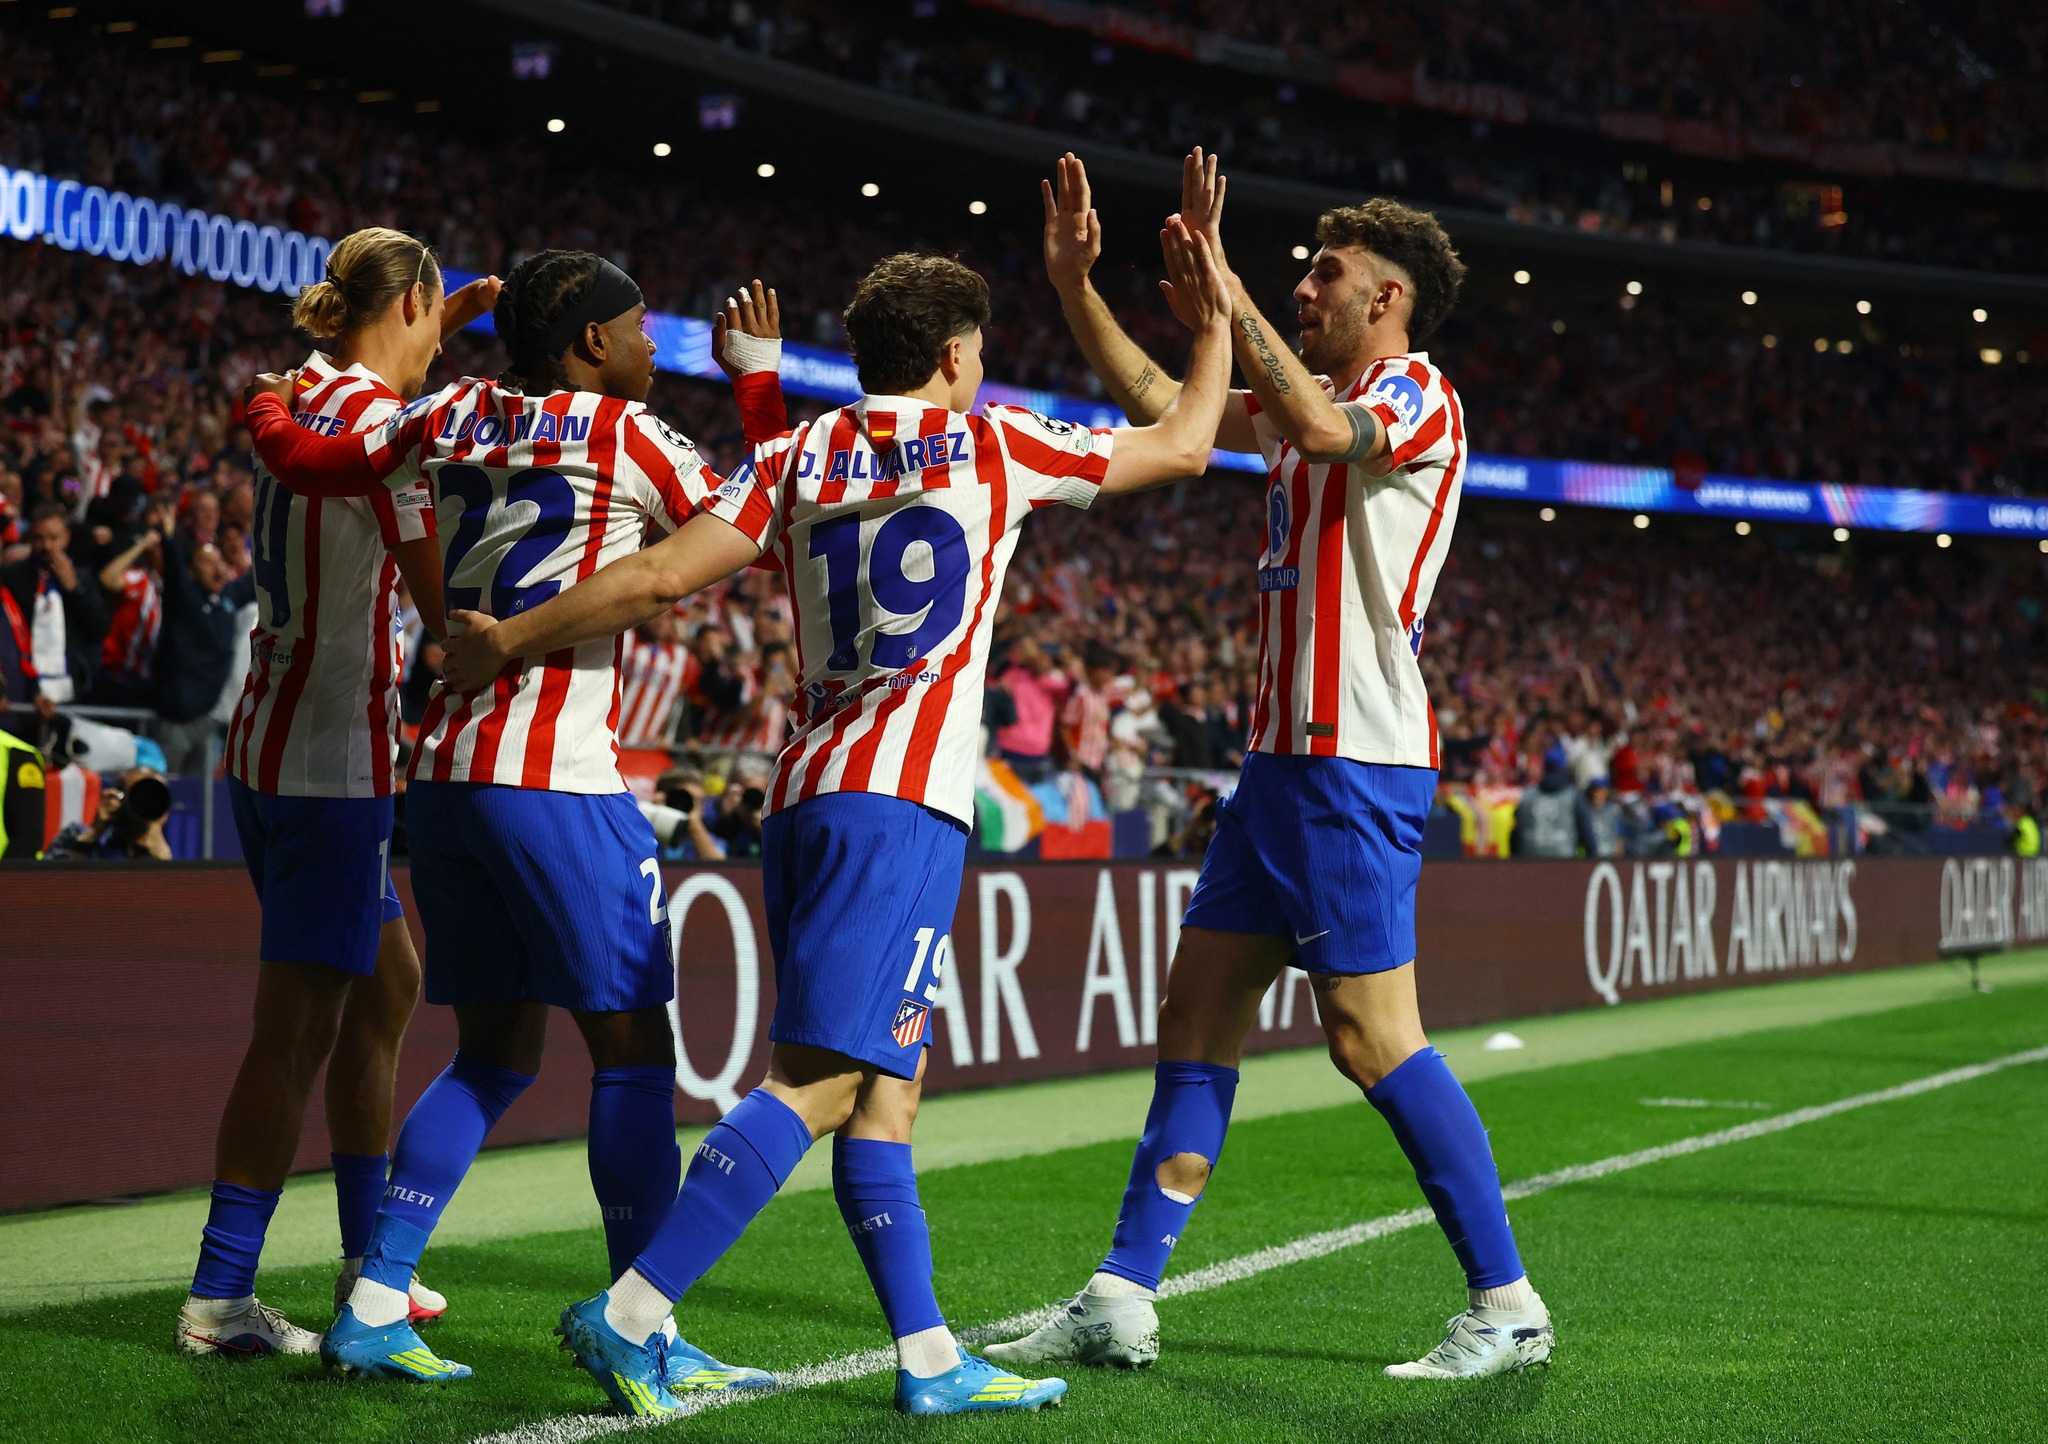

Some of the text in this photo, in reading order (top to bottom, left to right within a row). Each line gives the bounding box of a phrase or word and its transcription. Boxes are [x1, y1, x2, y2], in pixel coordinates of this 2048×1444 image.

[1241, 312, 1291, 394] Carpe Diem
[797, 431, 969, 482] J. ALVAREZ
[437, 464, 576, 620] 22
[1275, 568, 1296, 588] AIR
[808, 505, 971, 672] 19
[1584, 859, 1857, 1006] QATAR AIRWAYS
[385, 1184, 435, 1208] ATLETI
